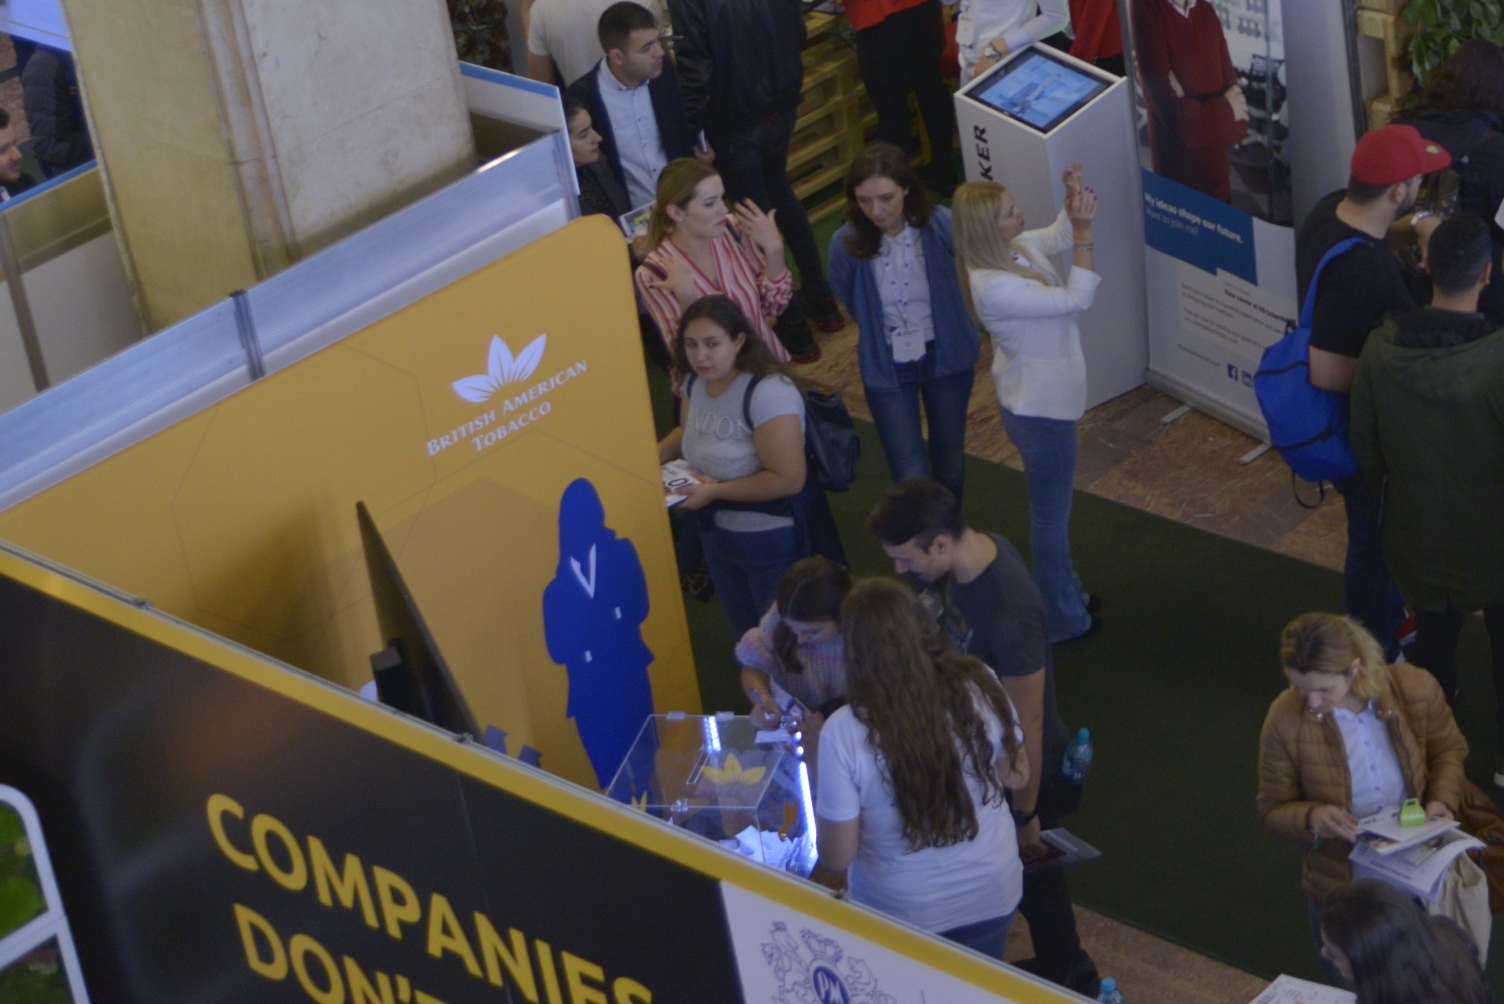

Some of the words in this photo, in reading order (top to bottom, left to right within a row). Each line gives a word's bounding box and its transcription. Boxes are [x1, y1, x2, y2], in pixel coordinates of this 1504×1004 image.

[1155, 197, 1177, 215] ideas
[1178, 207, 1202, 225] shape
[1202, 218, 1216, 232] our
[426, 409, 496, 457] BRITISH
[501, 359, 589, 416] AMERICAN
[471, 401, 553, 452] TOBACCO
[233, 903, 456, 1004] DON'
